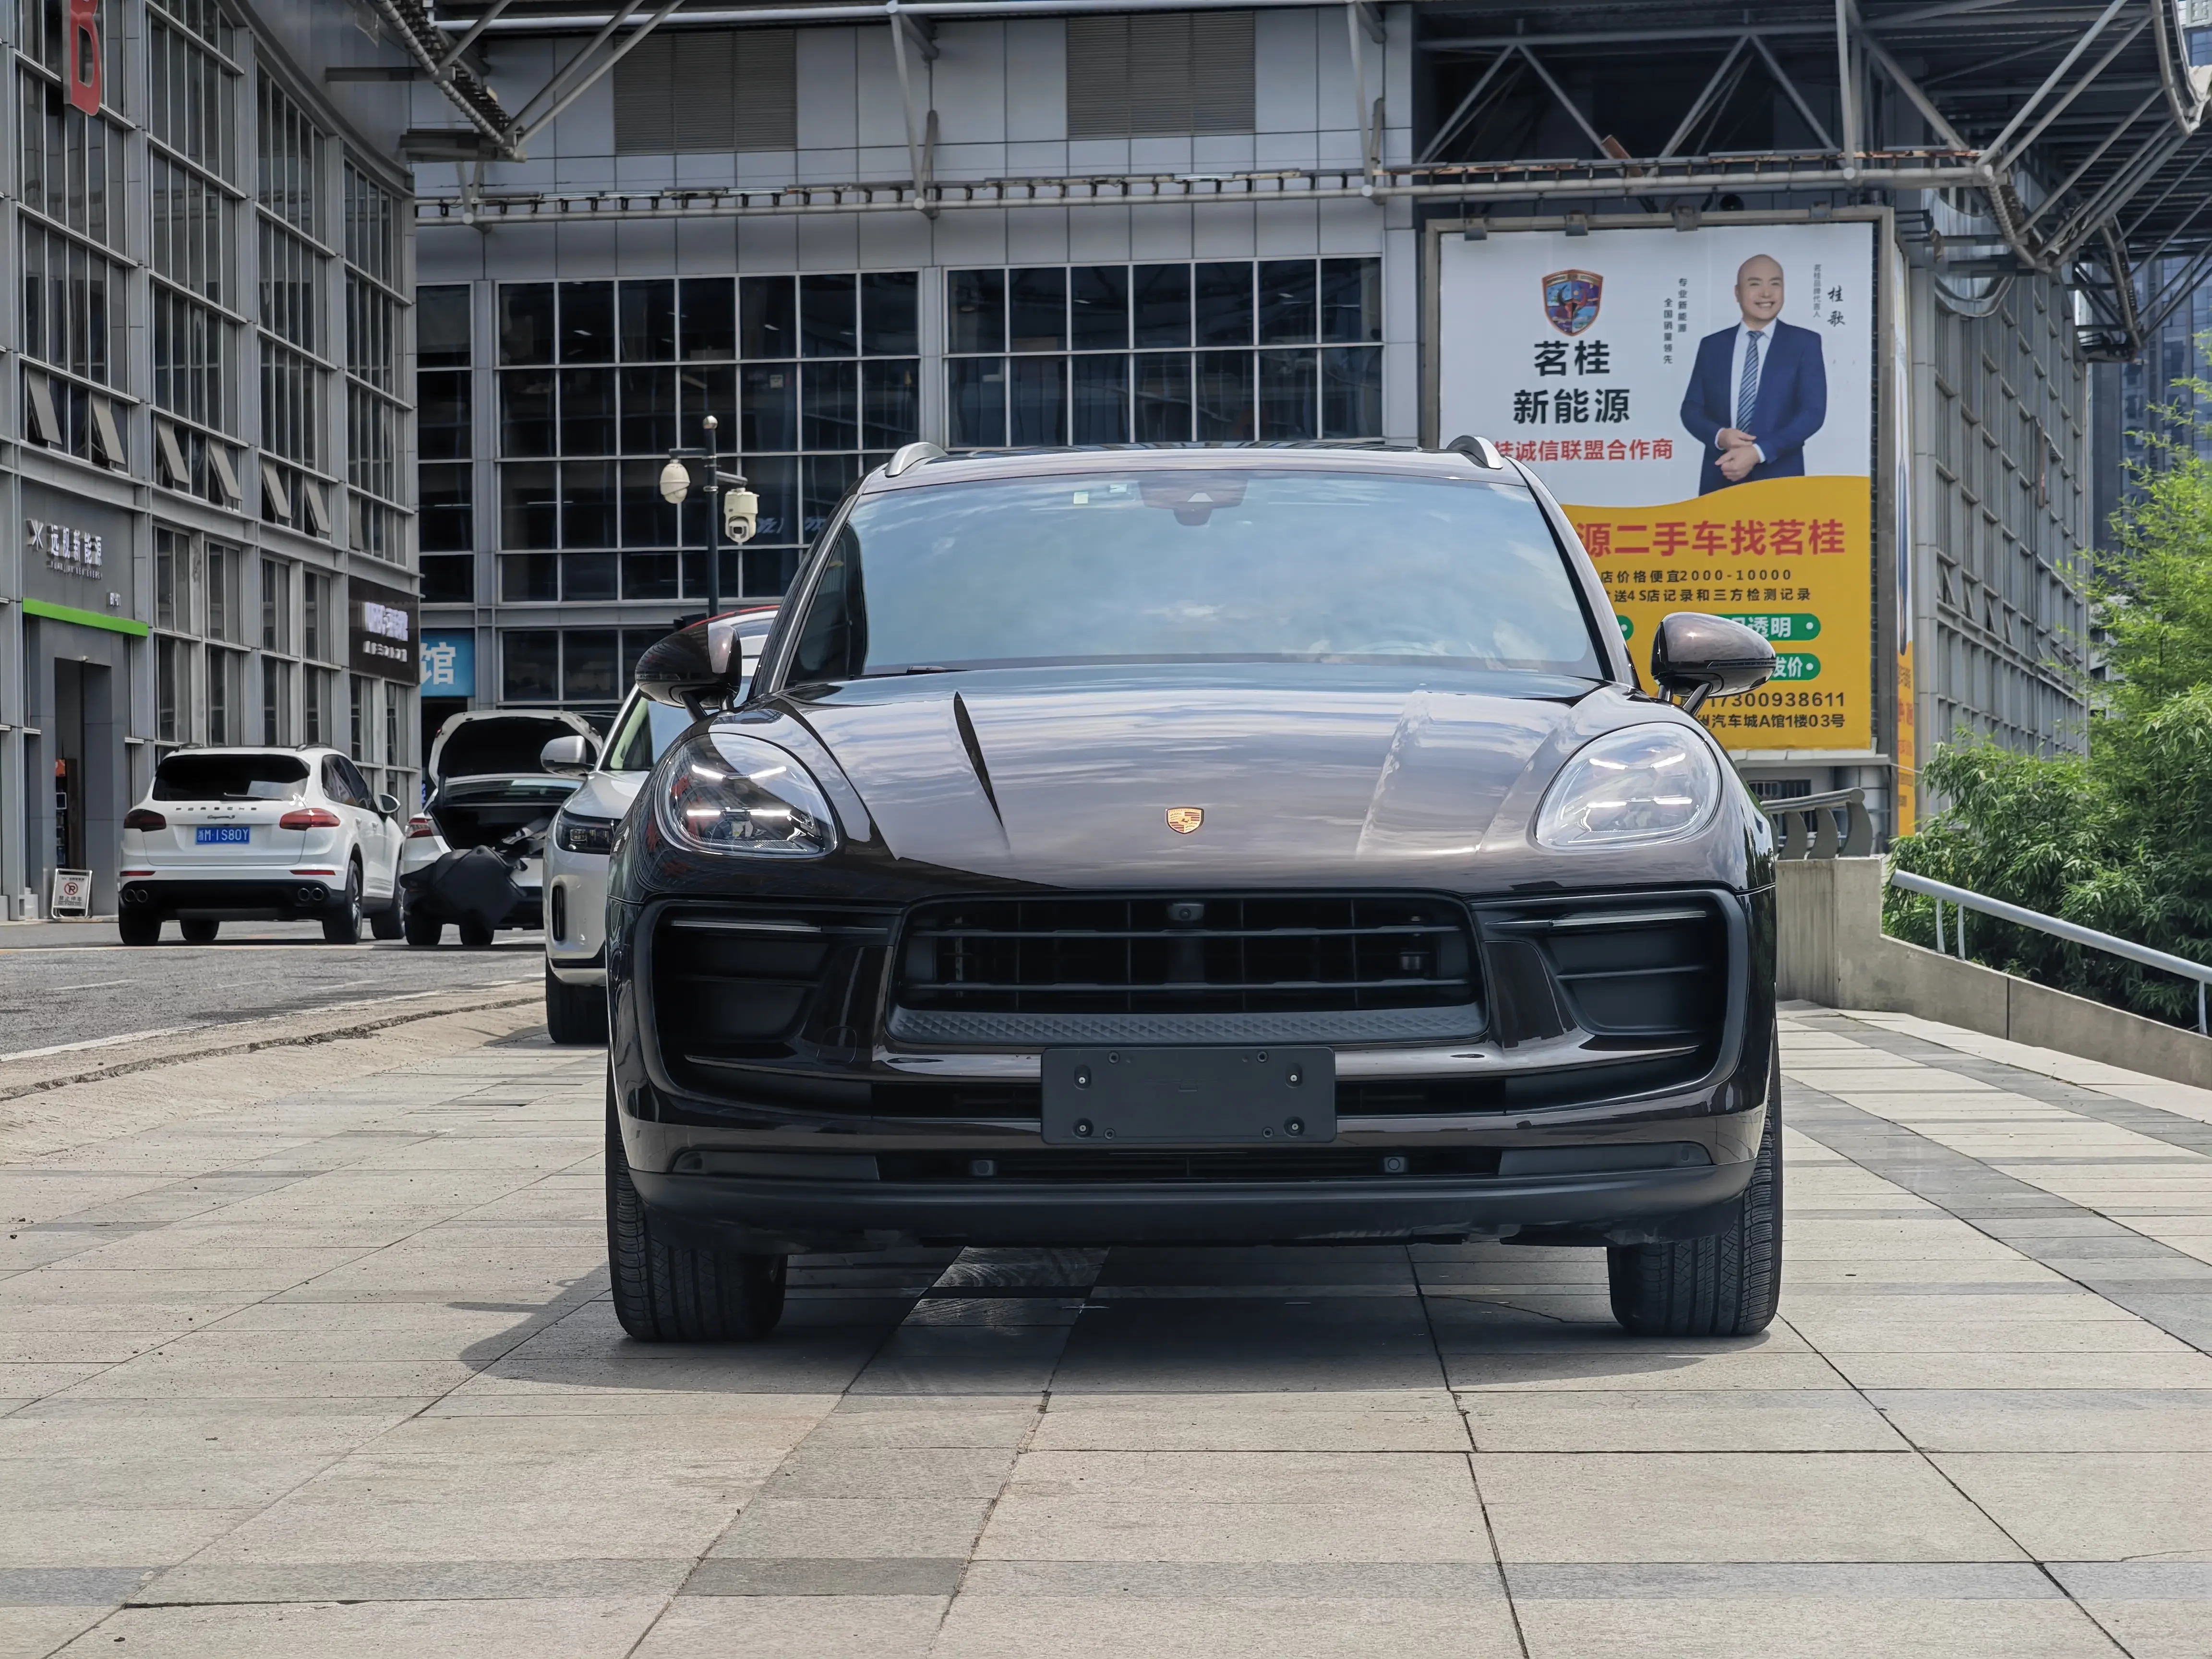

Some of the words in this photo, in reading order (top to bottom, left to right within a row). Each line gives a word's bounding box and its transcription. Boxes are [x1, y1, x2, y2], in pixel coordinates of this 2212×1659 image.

[1678, 278, 1688, 333] 专业新能源
[1827, 285, 1846, 327] 桂歌
[1663, 298, 1673, 364] 全国销量领先
[1534, 340, 1610, 376] 茗桂
[1513, 388, 1630, 424] 新能源
[1576, 518, 1845, 558] 源二手车找茗桂
[1606, 588, 1811, 602] 送4S店记录和三方检测记录
[421, 642, 456, 685] 馆
